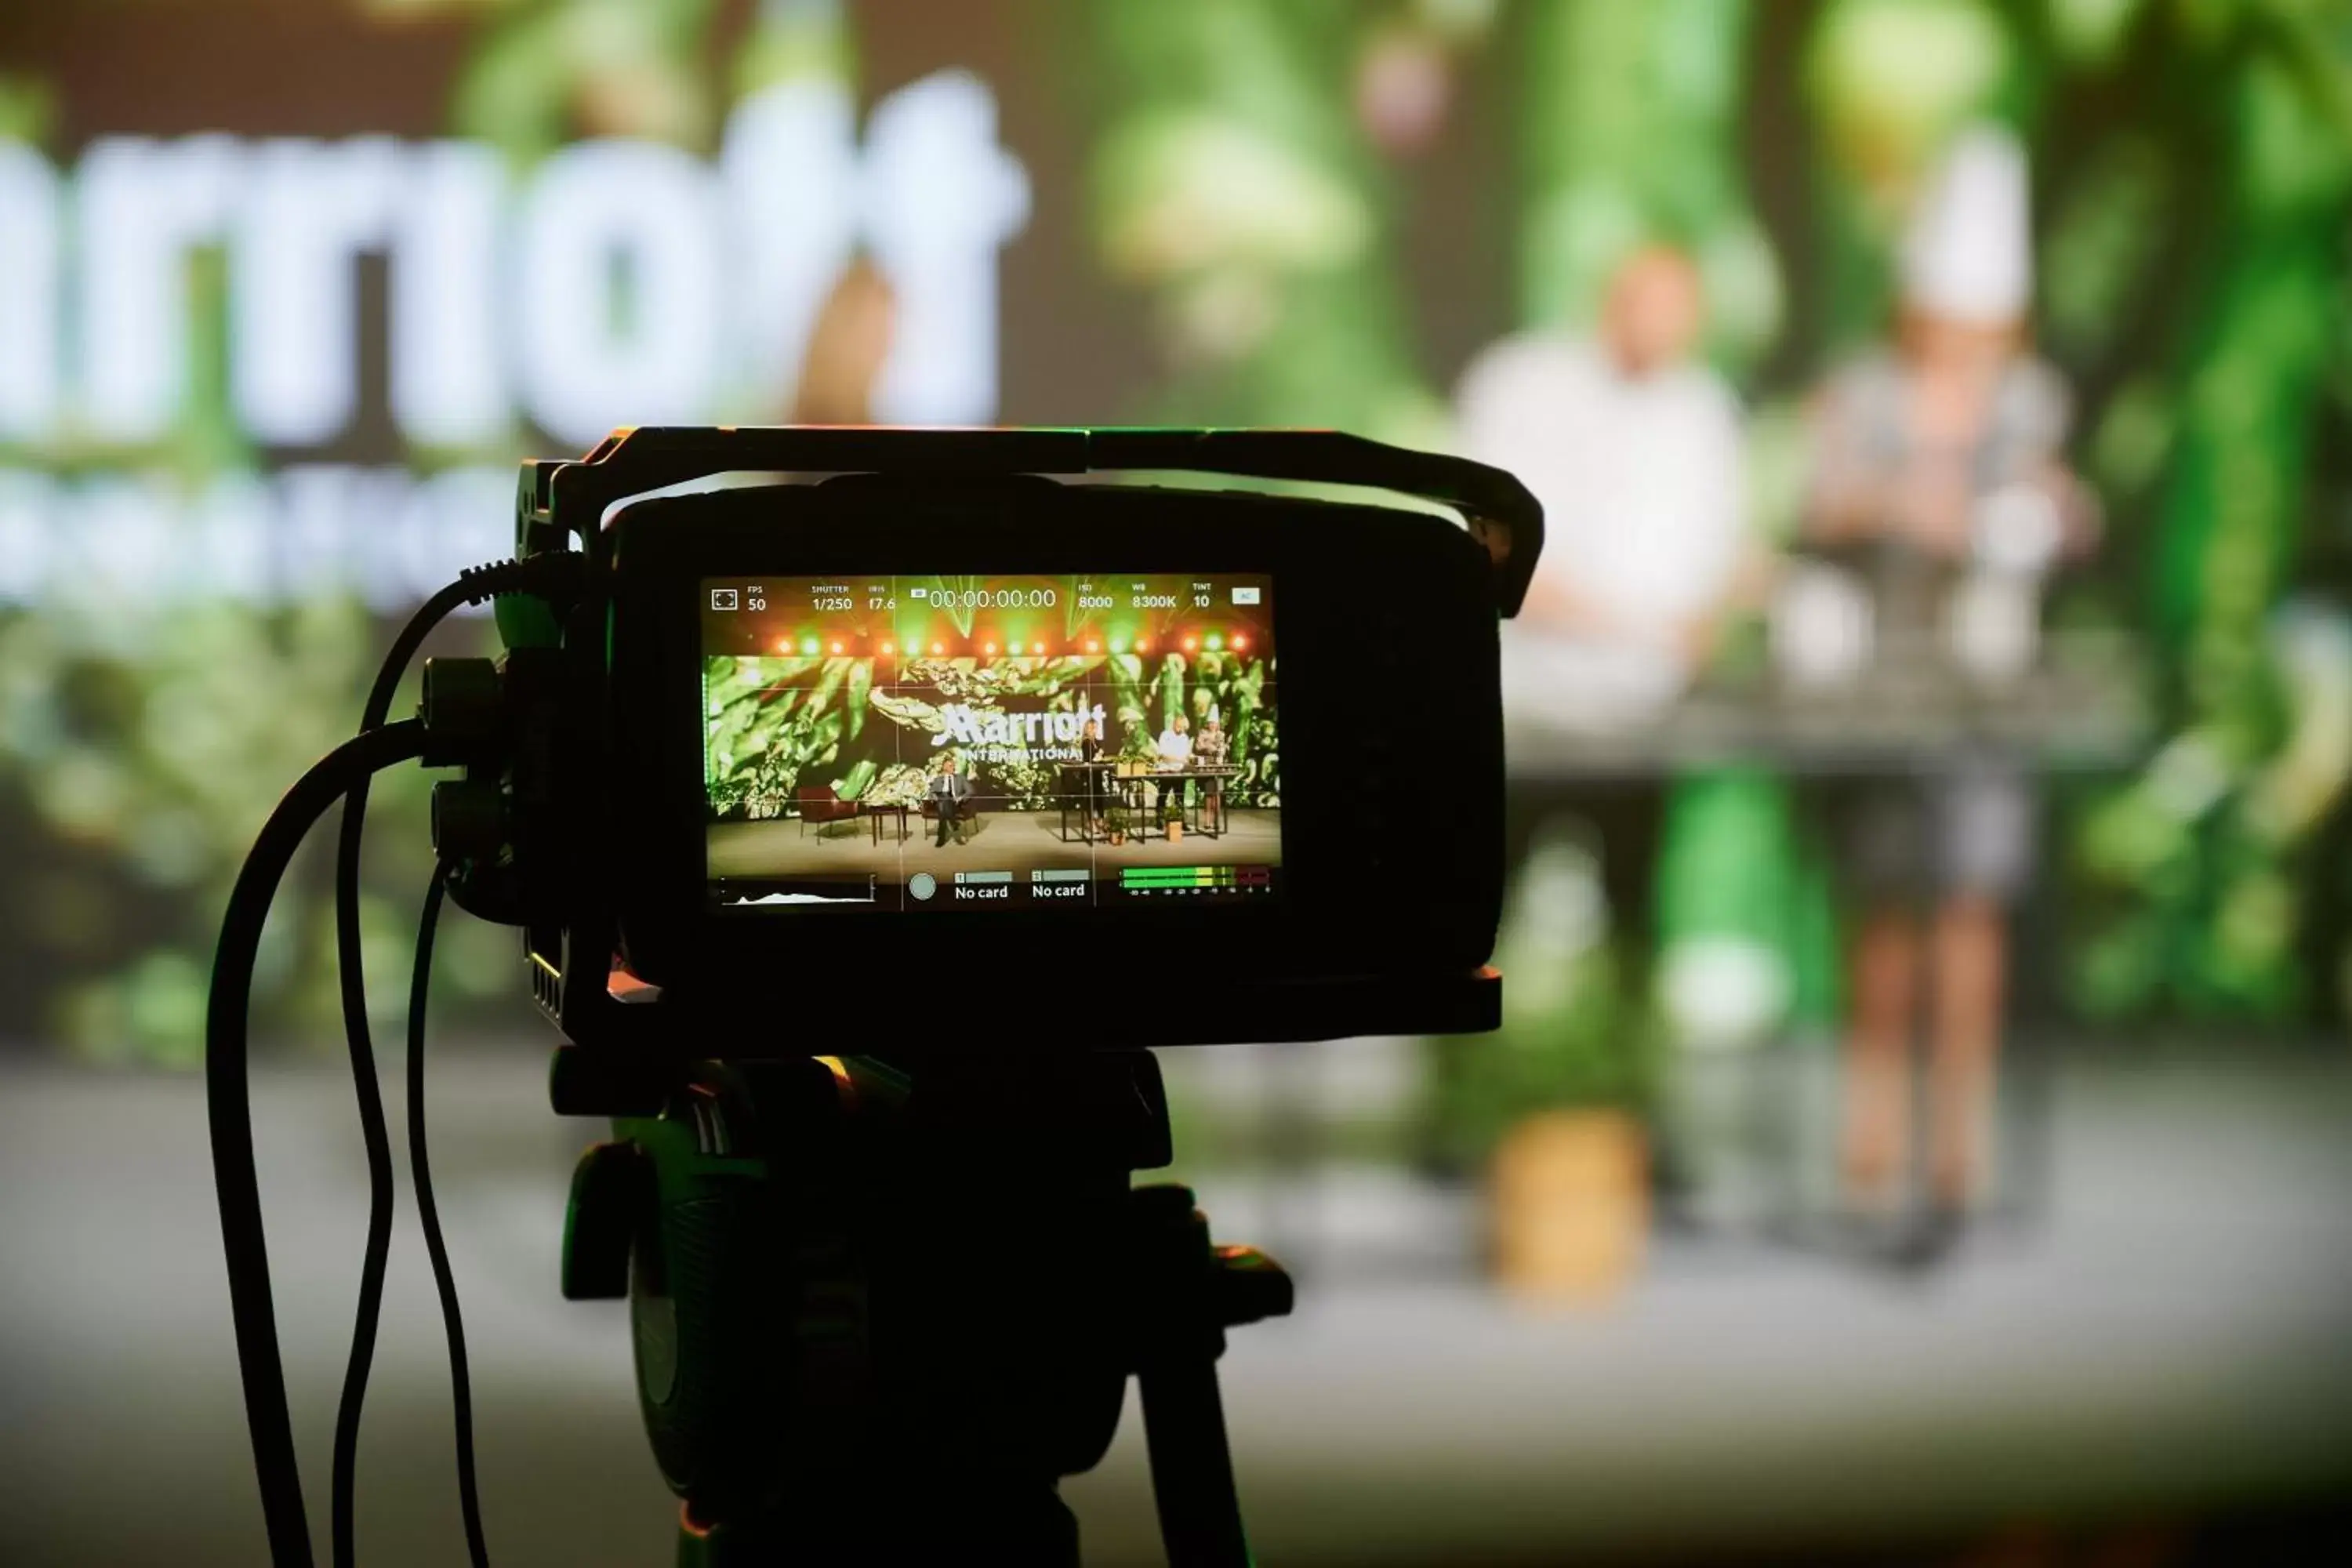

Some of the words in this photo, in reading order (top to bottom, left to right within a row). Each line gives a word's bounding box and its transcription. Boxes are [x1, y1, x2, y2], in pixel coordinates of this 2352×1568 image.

[811, 586, 849, 594] SHUTTER
[1192, 583, 1211, 591] TINT
[747, 598, 767, 611] 50
[812, 597, 853, 611] 1/250
[931, 589, 1056, 608] 00:00:00:00
[1078, 596, 1113, 608] 8000
[1132, 596, 1177, 608] 8300K
[1193, 596, 1210, 608] 10
[931, 702, 1107, 746] Marriott
[955, 887, 974, 899] No
[978, 885, 1009, 898] card
[1033, 885, 1052, 898] No
[1054, 884, 1085, 897] card
